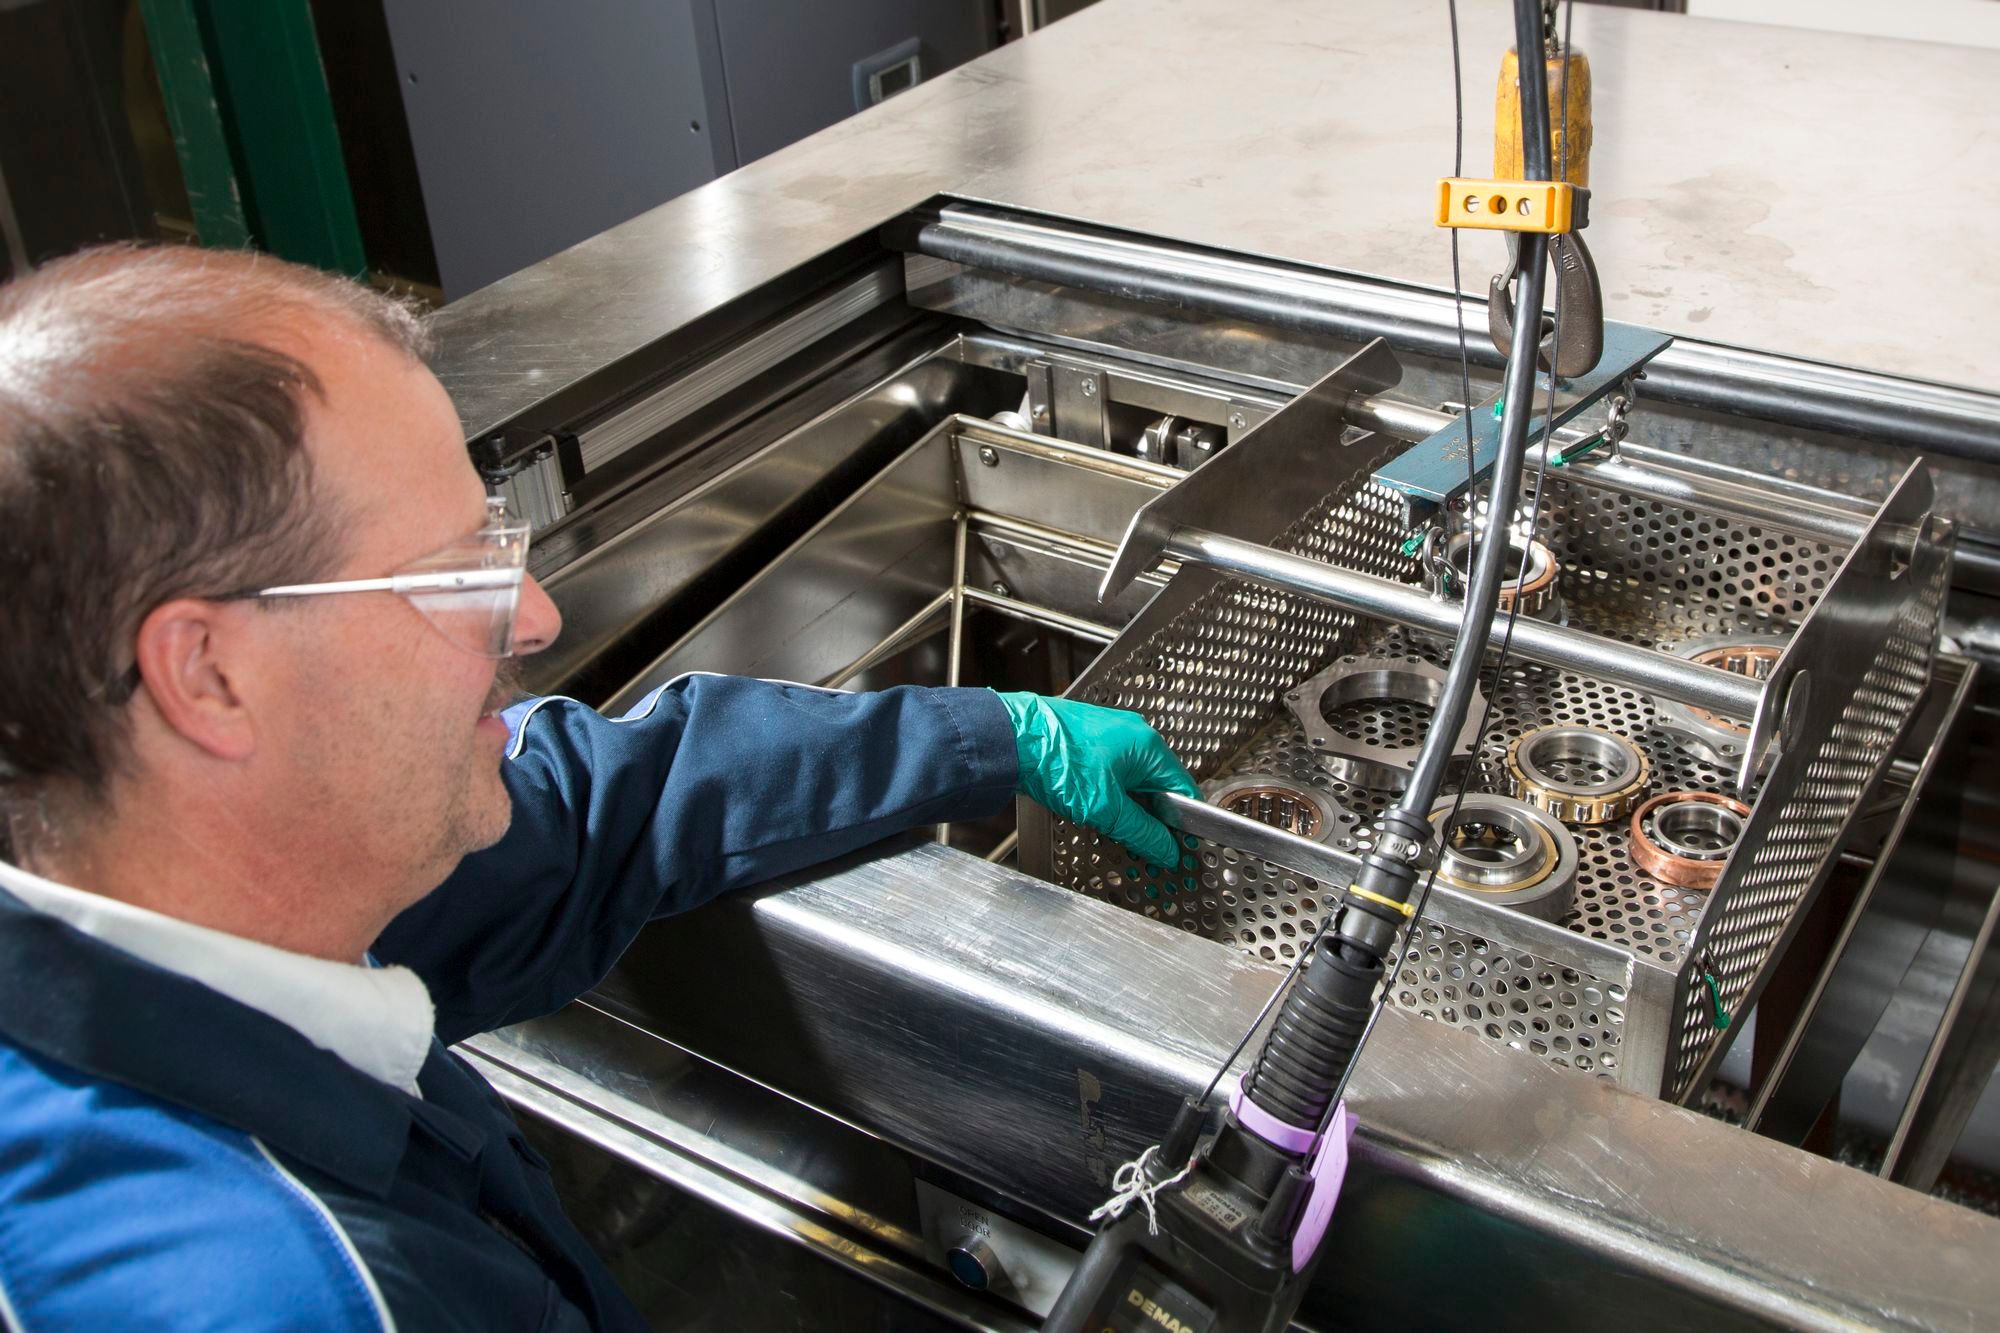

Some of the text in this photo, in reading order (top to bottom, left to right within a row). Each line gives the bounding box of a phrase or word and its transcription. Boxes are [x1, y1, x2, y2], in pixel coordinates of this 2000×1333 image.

[959, 1206, 990, 1226] OPEN
[1209, 1191, 1243, 1218] DEMAG
[961, 1216, 991, 1239] DOOR
